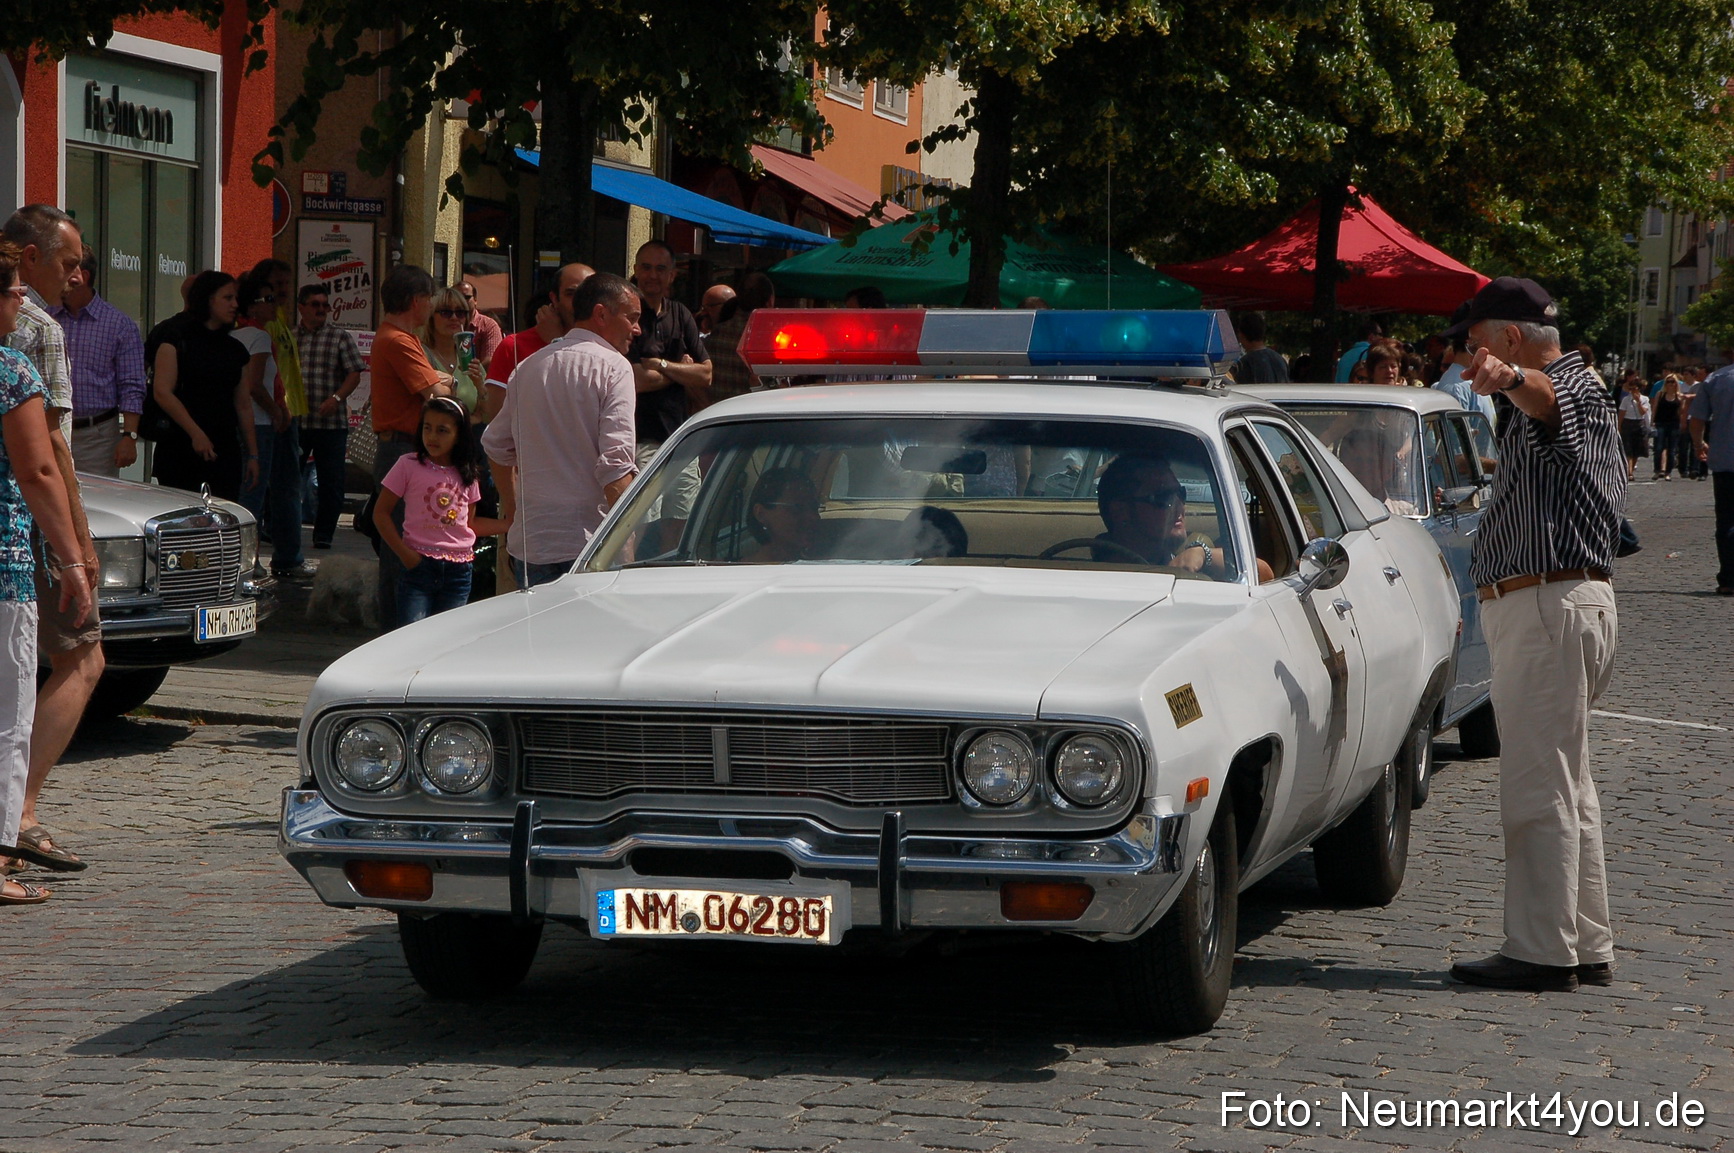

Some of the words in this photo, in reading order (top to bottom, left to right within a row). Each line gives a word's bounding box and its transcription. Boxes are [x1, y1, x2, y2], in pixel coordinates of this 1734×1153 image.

[85, 80, 174, 144] fielmann
[305, 196, 382, 213] Bockwirtsgasse
[322, 272, 371, 295] NEZIA
[207, 611, 221, 636] NM
[228, 609, 240, 633] RH
[1168, 687, 1201, 725] SHERIFF
[600, 915, 609, 926] D
[625, 892, 678, 930] NM
[703, 894, 825, 937] 06280
